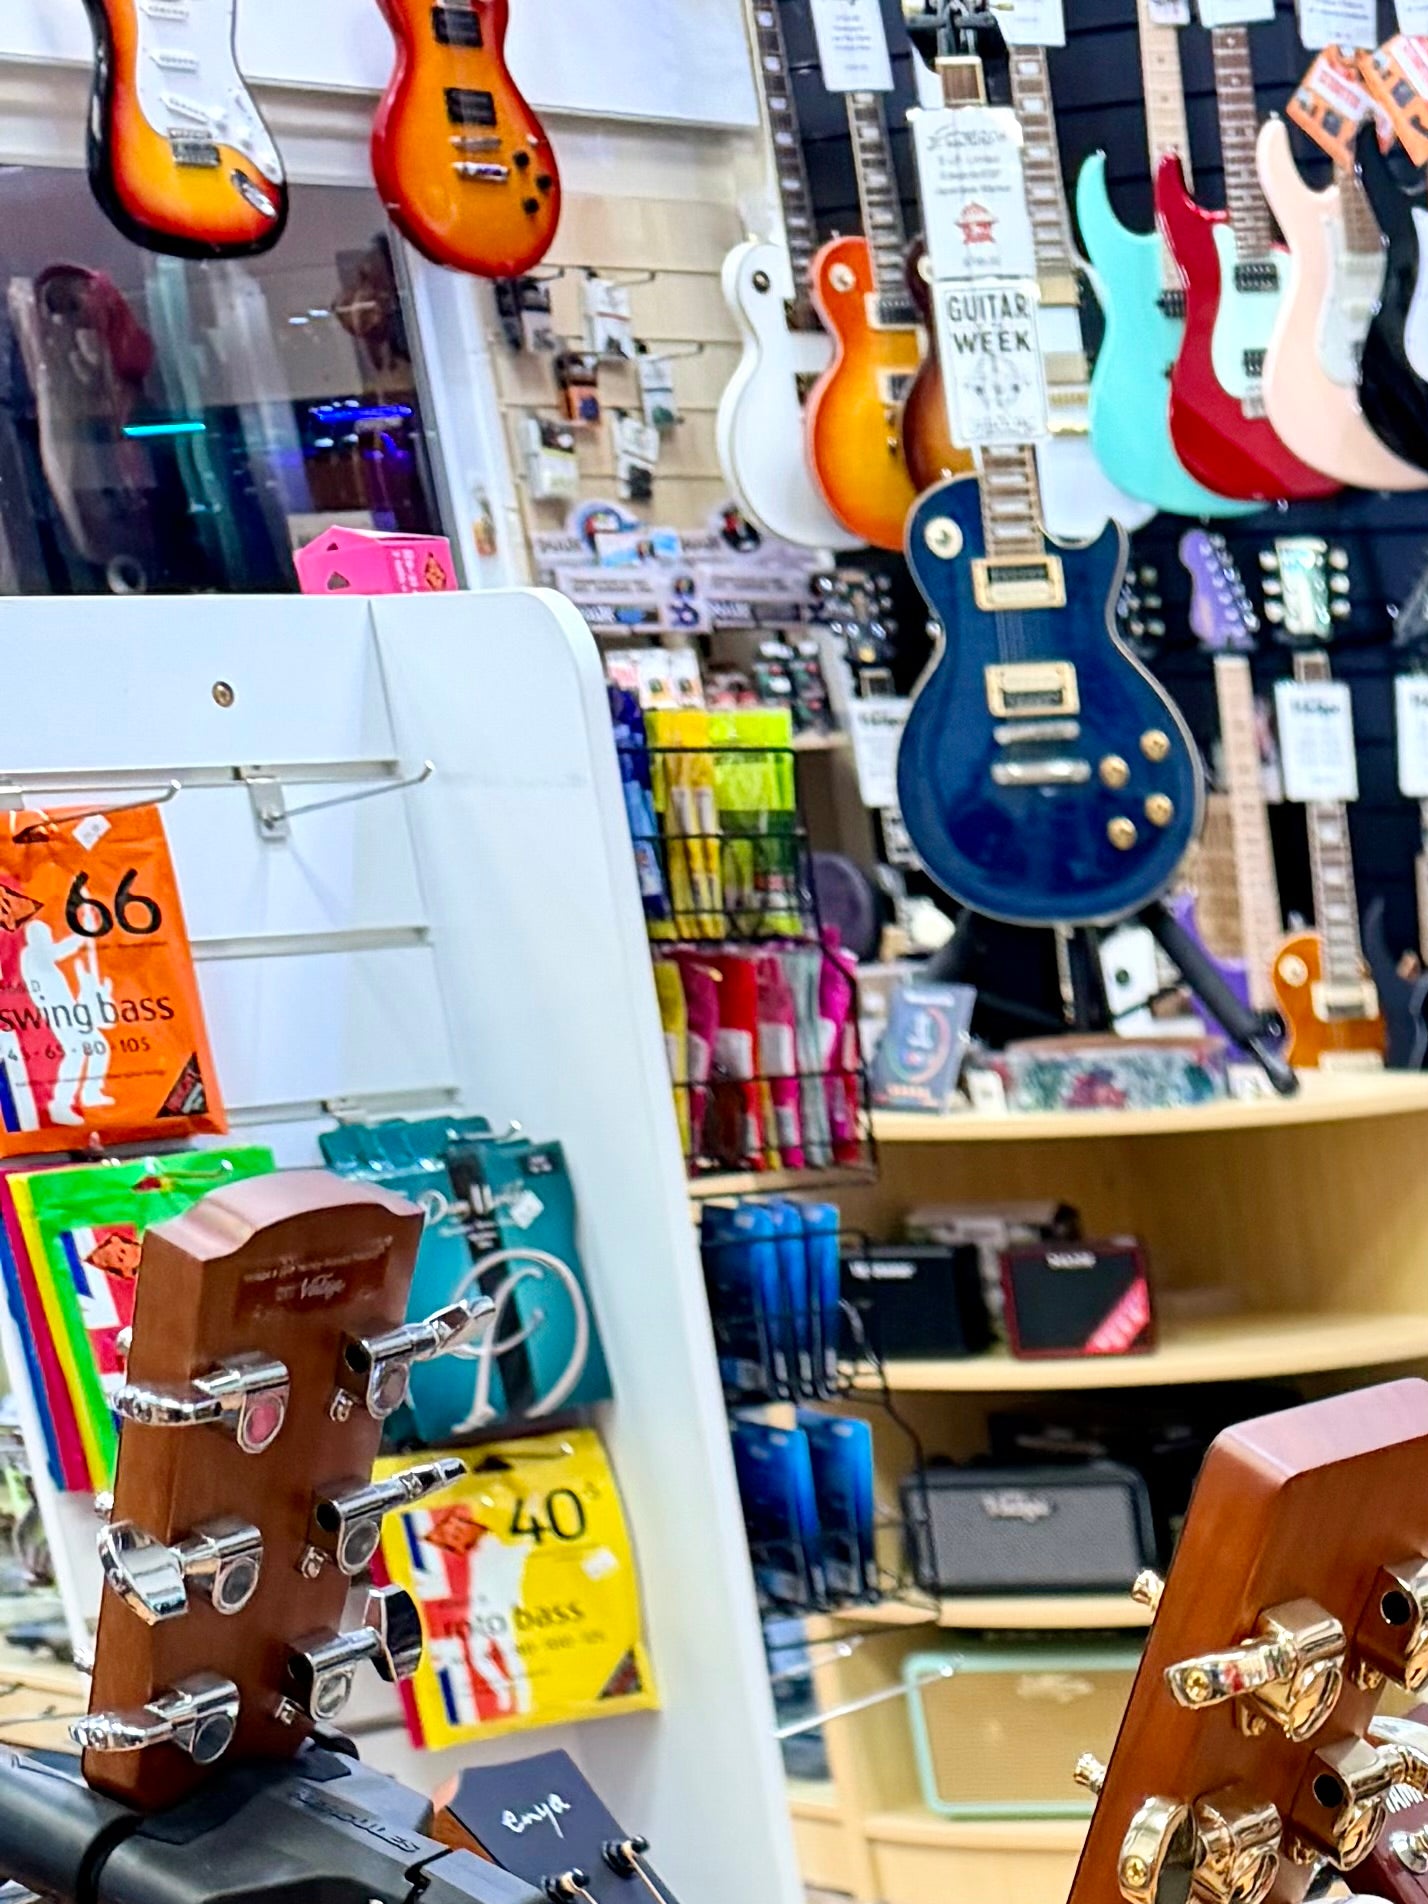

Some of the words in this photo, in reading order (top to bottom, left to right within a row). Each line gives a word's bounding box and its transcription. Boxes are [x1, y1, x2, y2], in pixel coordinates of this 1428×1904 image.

[949, 292, 1031, 322] GUITAR
[952, 330, 1032, 354] WEEK
[65, 868, 162, 938] 66
[0, 994, 98, 1034] swing
[97, 991, 175, 1024] bass
[120, 1037, 151, 1053] 105
[510, 1488, 586, 1544] 40
[501, 1792, 572, 1839] enya
